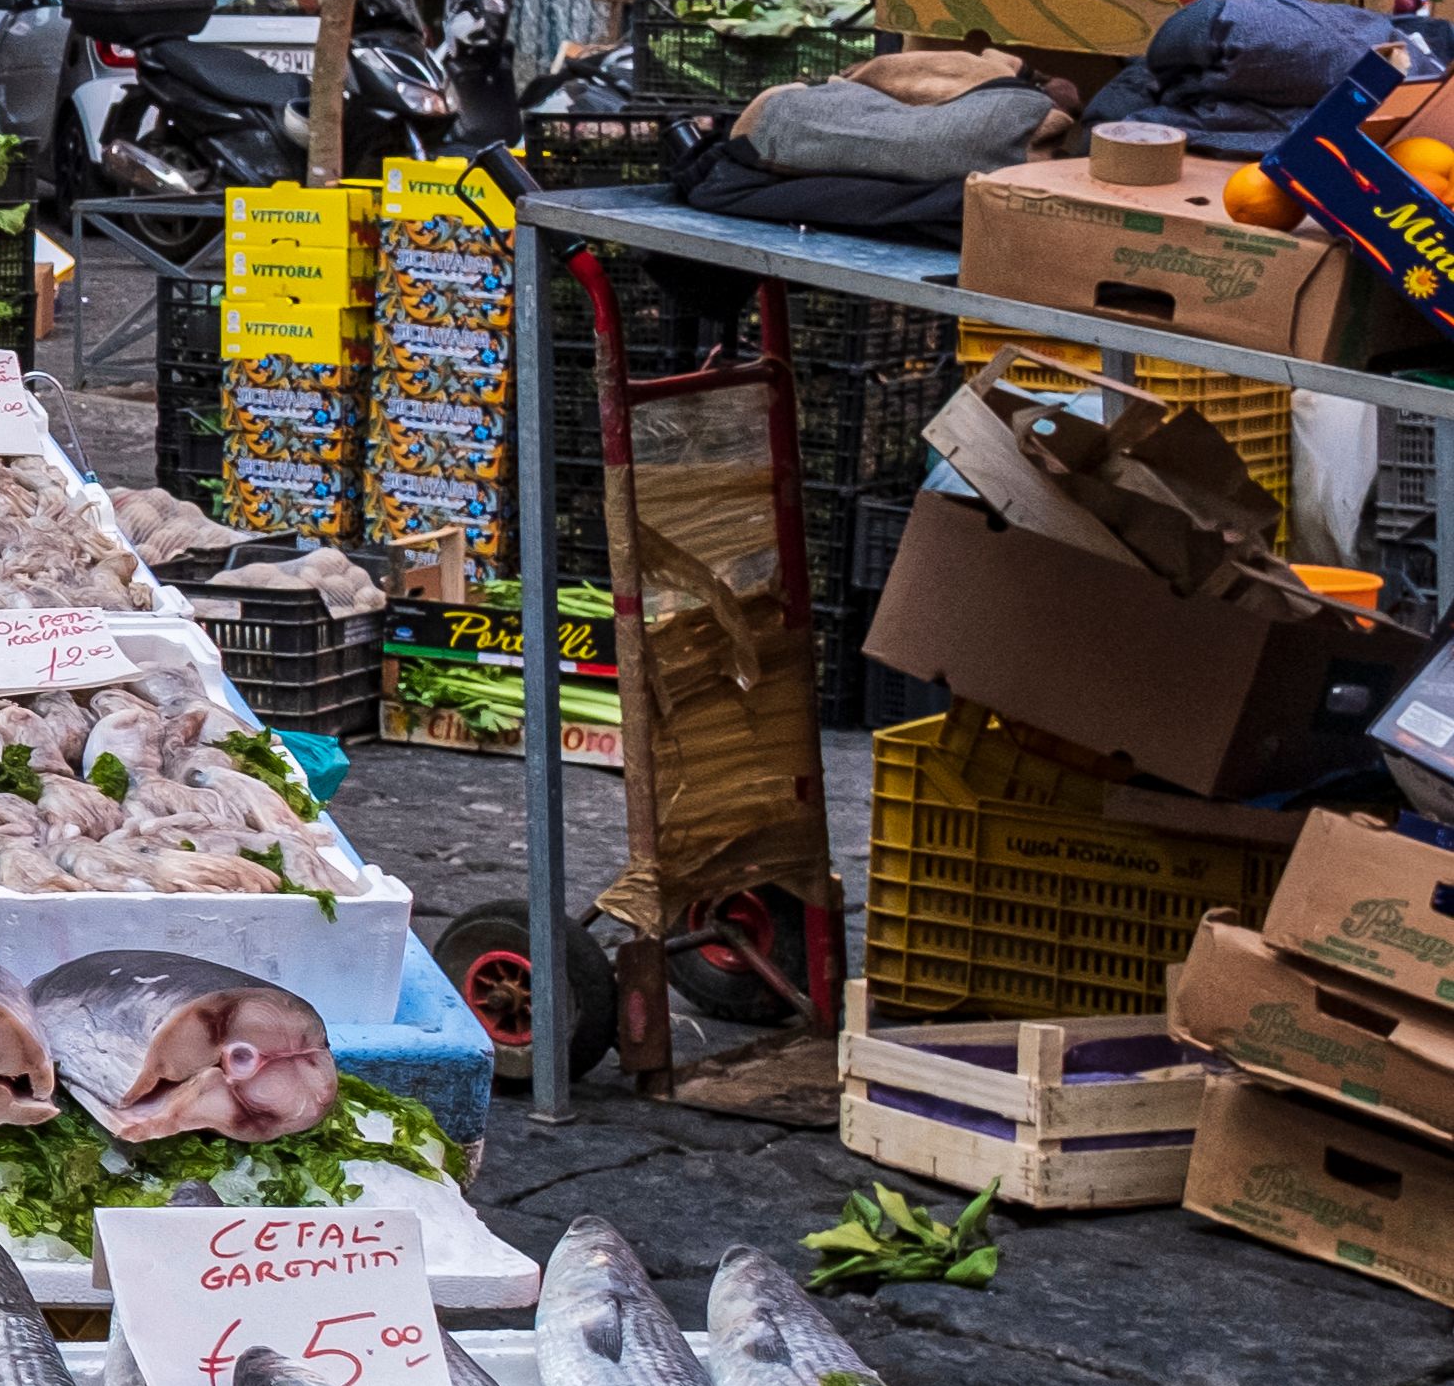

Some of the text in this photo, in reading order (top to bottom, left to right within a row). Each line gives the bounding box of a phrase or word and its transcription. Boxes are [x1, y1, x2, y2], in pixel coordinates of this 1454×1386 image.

[407, 180, 486, 200] VITTORIA
[250, 209, 322, 225] VITTORIA
[251, 264, 324, 280] VITTORIA
[244, 322, 315, 340] VITTORIA
